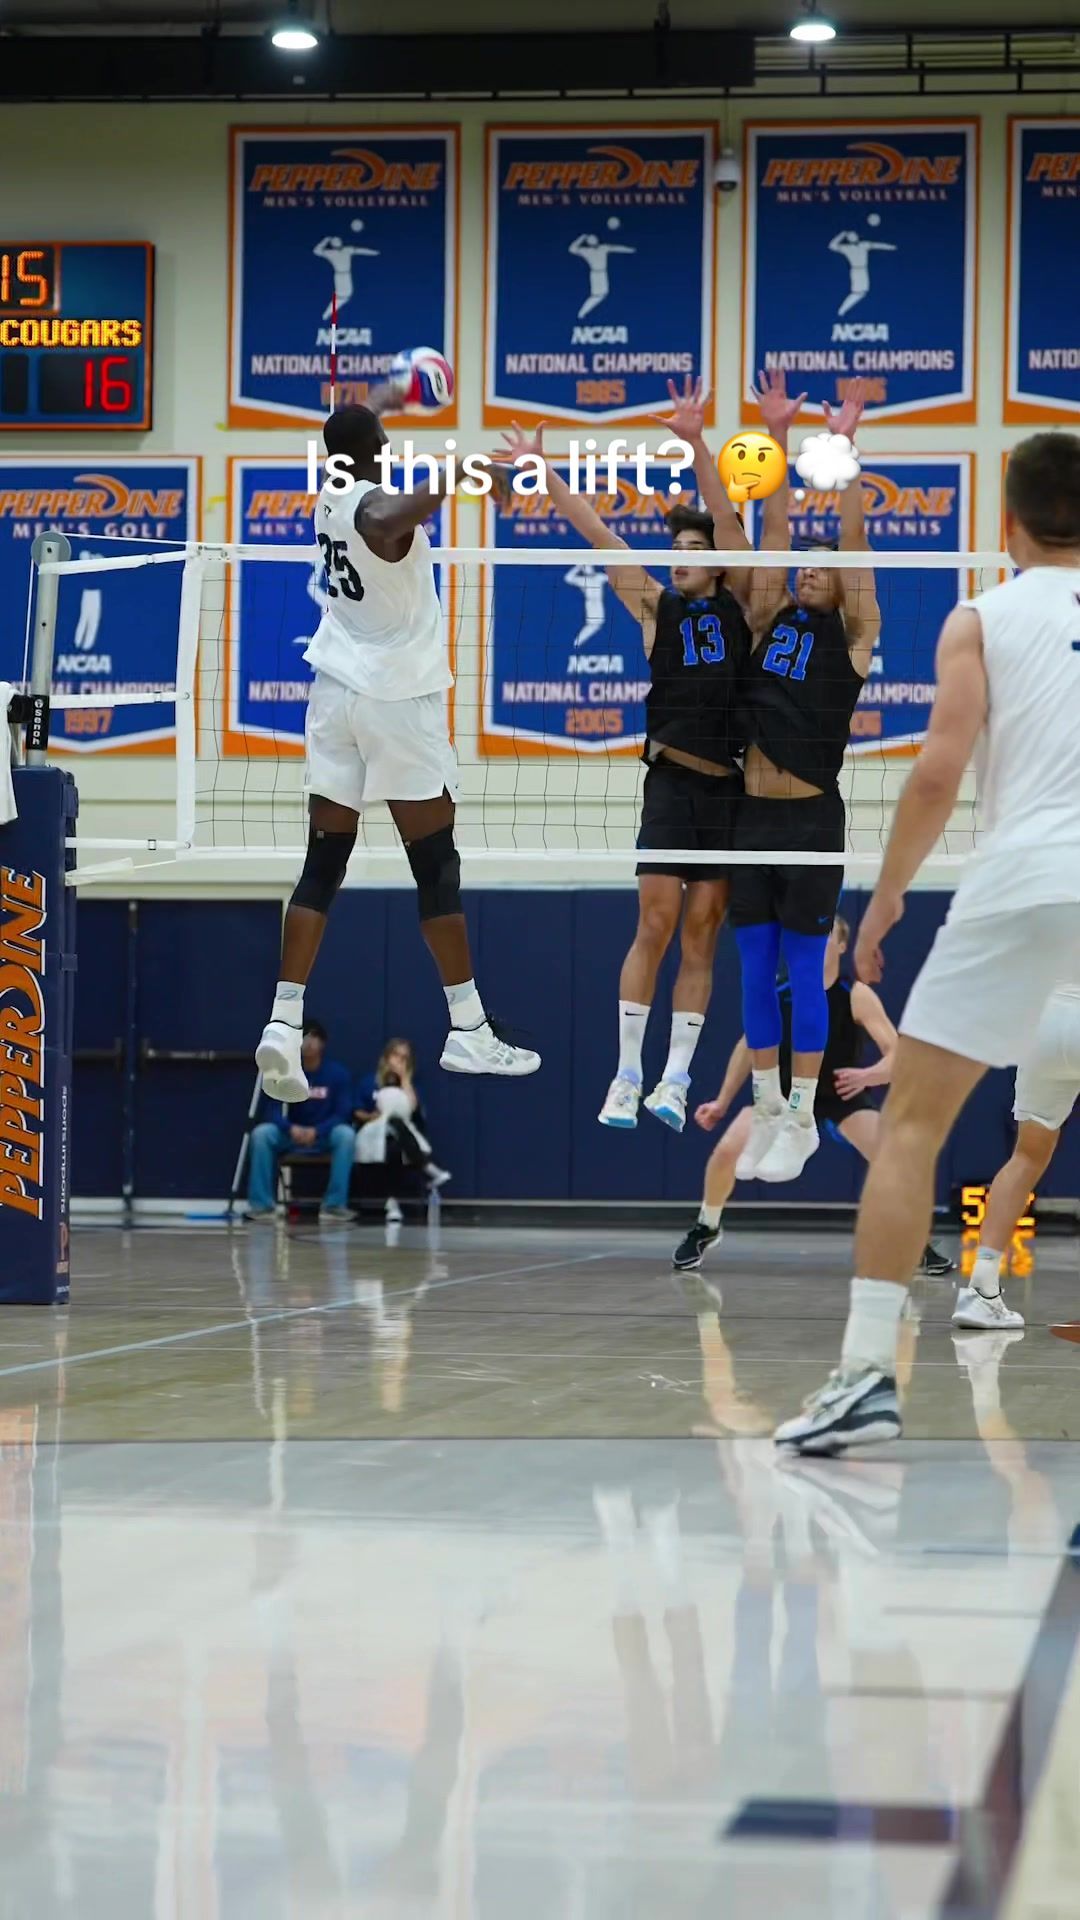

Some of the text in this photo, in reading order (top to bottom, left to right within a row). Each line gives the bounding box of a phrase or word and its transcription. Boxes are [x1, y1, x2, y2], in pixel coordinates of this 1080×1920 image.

[249, 148, 442, 192] PEPPERDINE
[502, 145, 699, 189] PEPPERDINE
[761, 142, 961, 187] PEPPERDINE
[264, 195, 428, 207] MEN'S VOLLEYBALL
[518, 192, 687, 206] MEN'S VOLLEYBALL
[777, 189, 948, 202] MEN'S VOLLEYBALL
[1, 251, 48, 306] 15
[0, 319, 142, 347] COUGARS
[316, 328, 372, 346] NCAA
[571, 326, 628, 344] NCAA
[831, 323, 889, 342] NCAA
[251, 354, 332, 375] NATIONAL
[506, 352, 693, 374] NATIONAL CHAMPIONS
[765, 350, 955, 372] NATIONAL CHAMPIONS
[1028, 349, 1080, 370] NATIO
[85, 356, 132, 412] 16
[13, 522, 166, 539] MEN'S GOLF
[680, 614, 725, 666] 13
[762, 624, 814, 680] 21
[57, 655, 112, 674] NCAA
[567, 655, 624, 674] NCAA
[502, 681, 585, 702] NATIONAL
[0, 867, 47, 1221] PEPPERDINE
